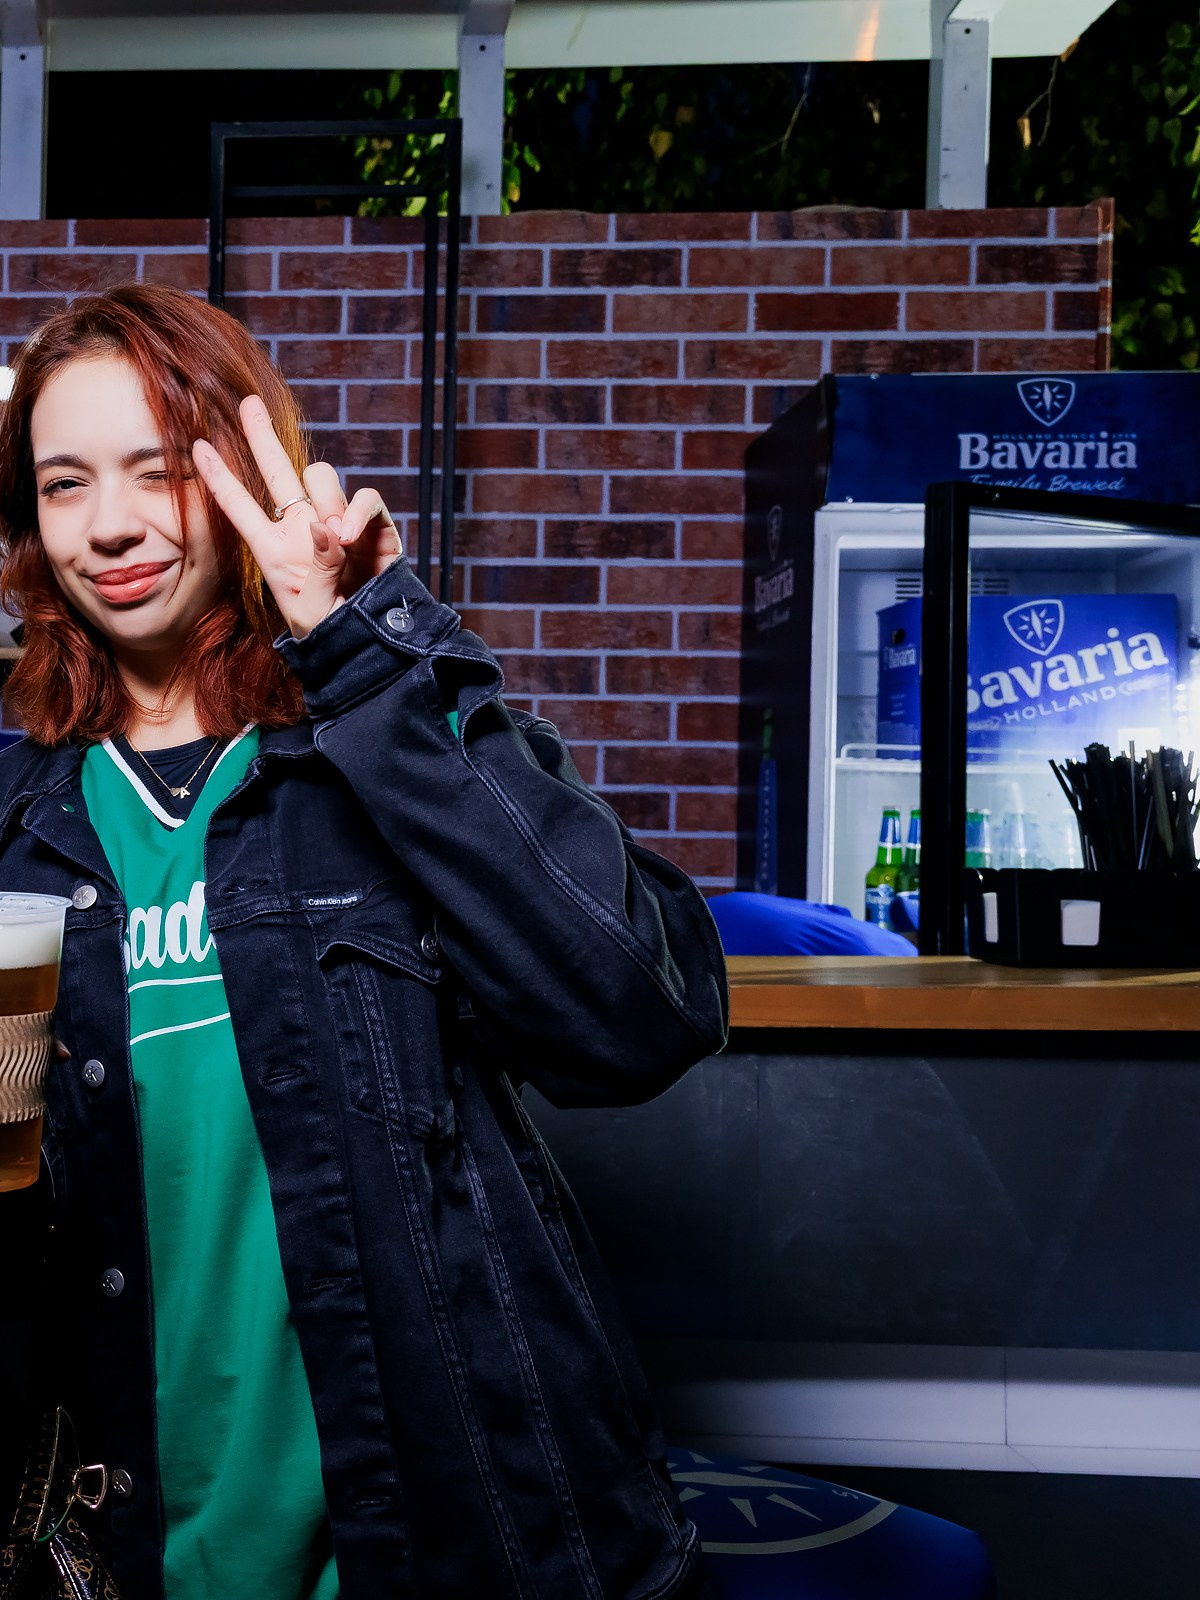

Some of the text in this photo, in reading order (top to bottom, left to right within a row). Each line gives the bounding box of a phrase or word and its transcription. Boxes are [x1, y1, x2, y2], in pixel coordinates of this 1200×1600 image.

[957, 430, 1138, 470] Bavaria
[1047, 474, 1128, 493] Brewed
[1003, 685, 1118, 724] HOLLAND
